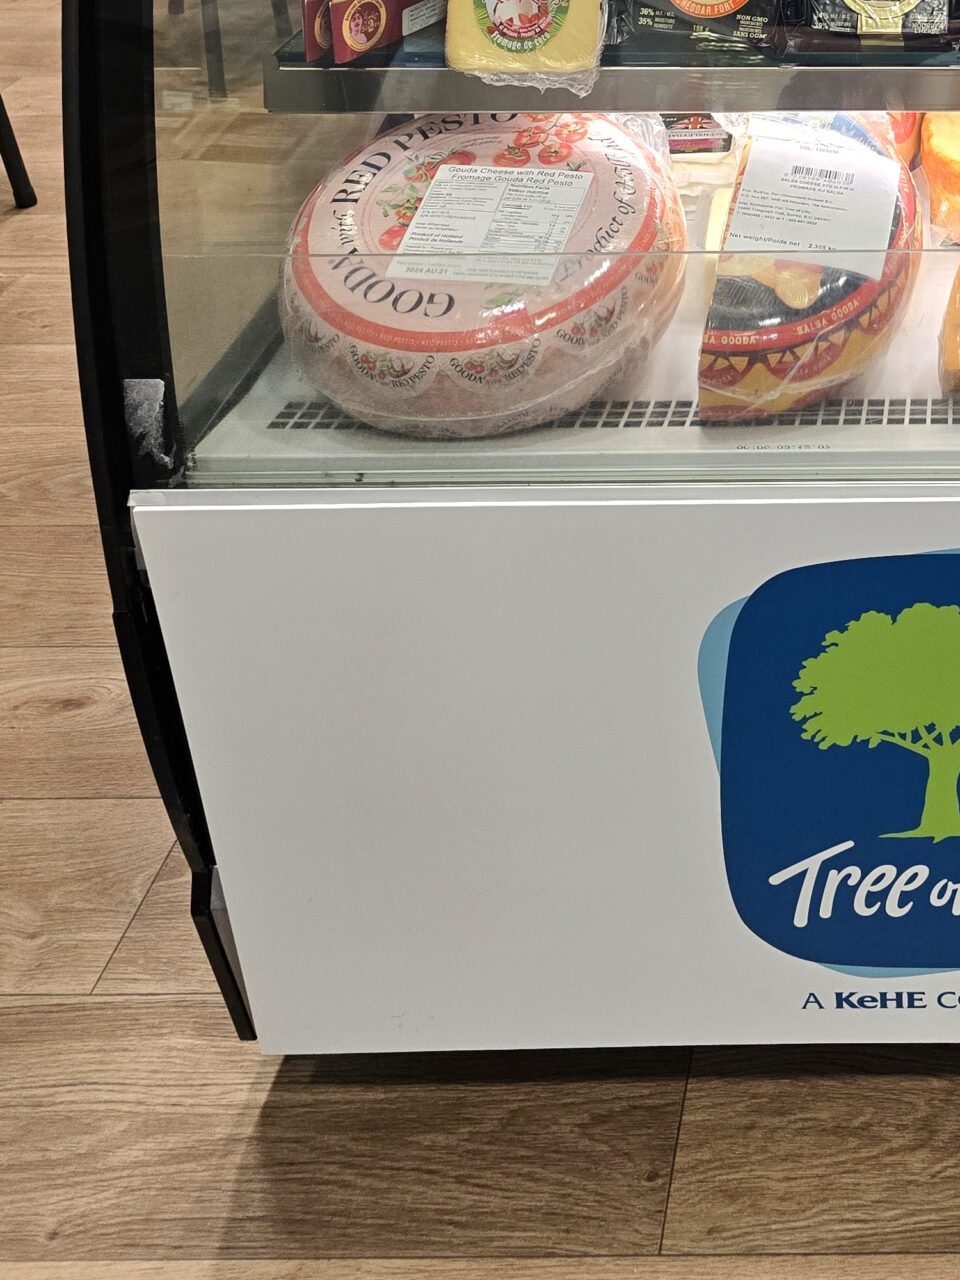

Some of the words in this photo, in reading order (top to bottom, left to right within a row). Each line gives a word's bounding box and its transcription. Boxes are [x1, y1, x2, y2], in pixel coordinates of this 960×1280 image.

[639, 7, 655, 16] 36%
[713, 0, 736, 15] FORT
[638, 16, 653, 26] 35%
[735, 14, 751, 23] NON
[330, 152, 392, 205] RED
[448, 166, 478, 175] Gouda
[480, 167, 516, 176] Cheese
[536, 171, 557, 179] Red
[557, 173, 584, 181] Pesto
[451, 173, 492, 182] Fromage
[494, 176, 524, 184] Gouda
[525, 177, 546, 185] Red
[547, 179, 574, 188] Pesto
[332, 247, 456, 318] GOODA
[796, 318, 828, 335] SALSA
[830, 299, 860, 321] GOODA
[348, 343, 377, 382] GOODA
[408, 354, 436, 386] PESTO
[449, 356, 485, 385] GOODA
[768, 839, 930, 928] Tree
[801, 992, 825, 1011] A
[834, 991, 928, 1011] KeHE
